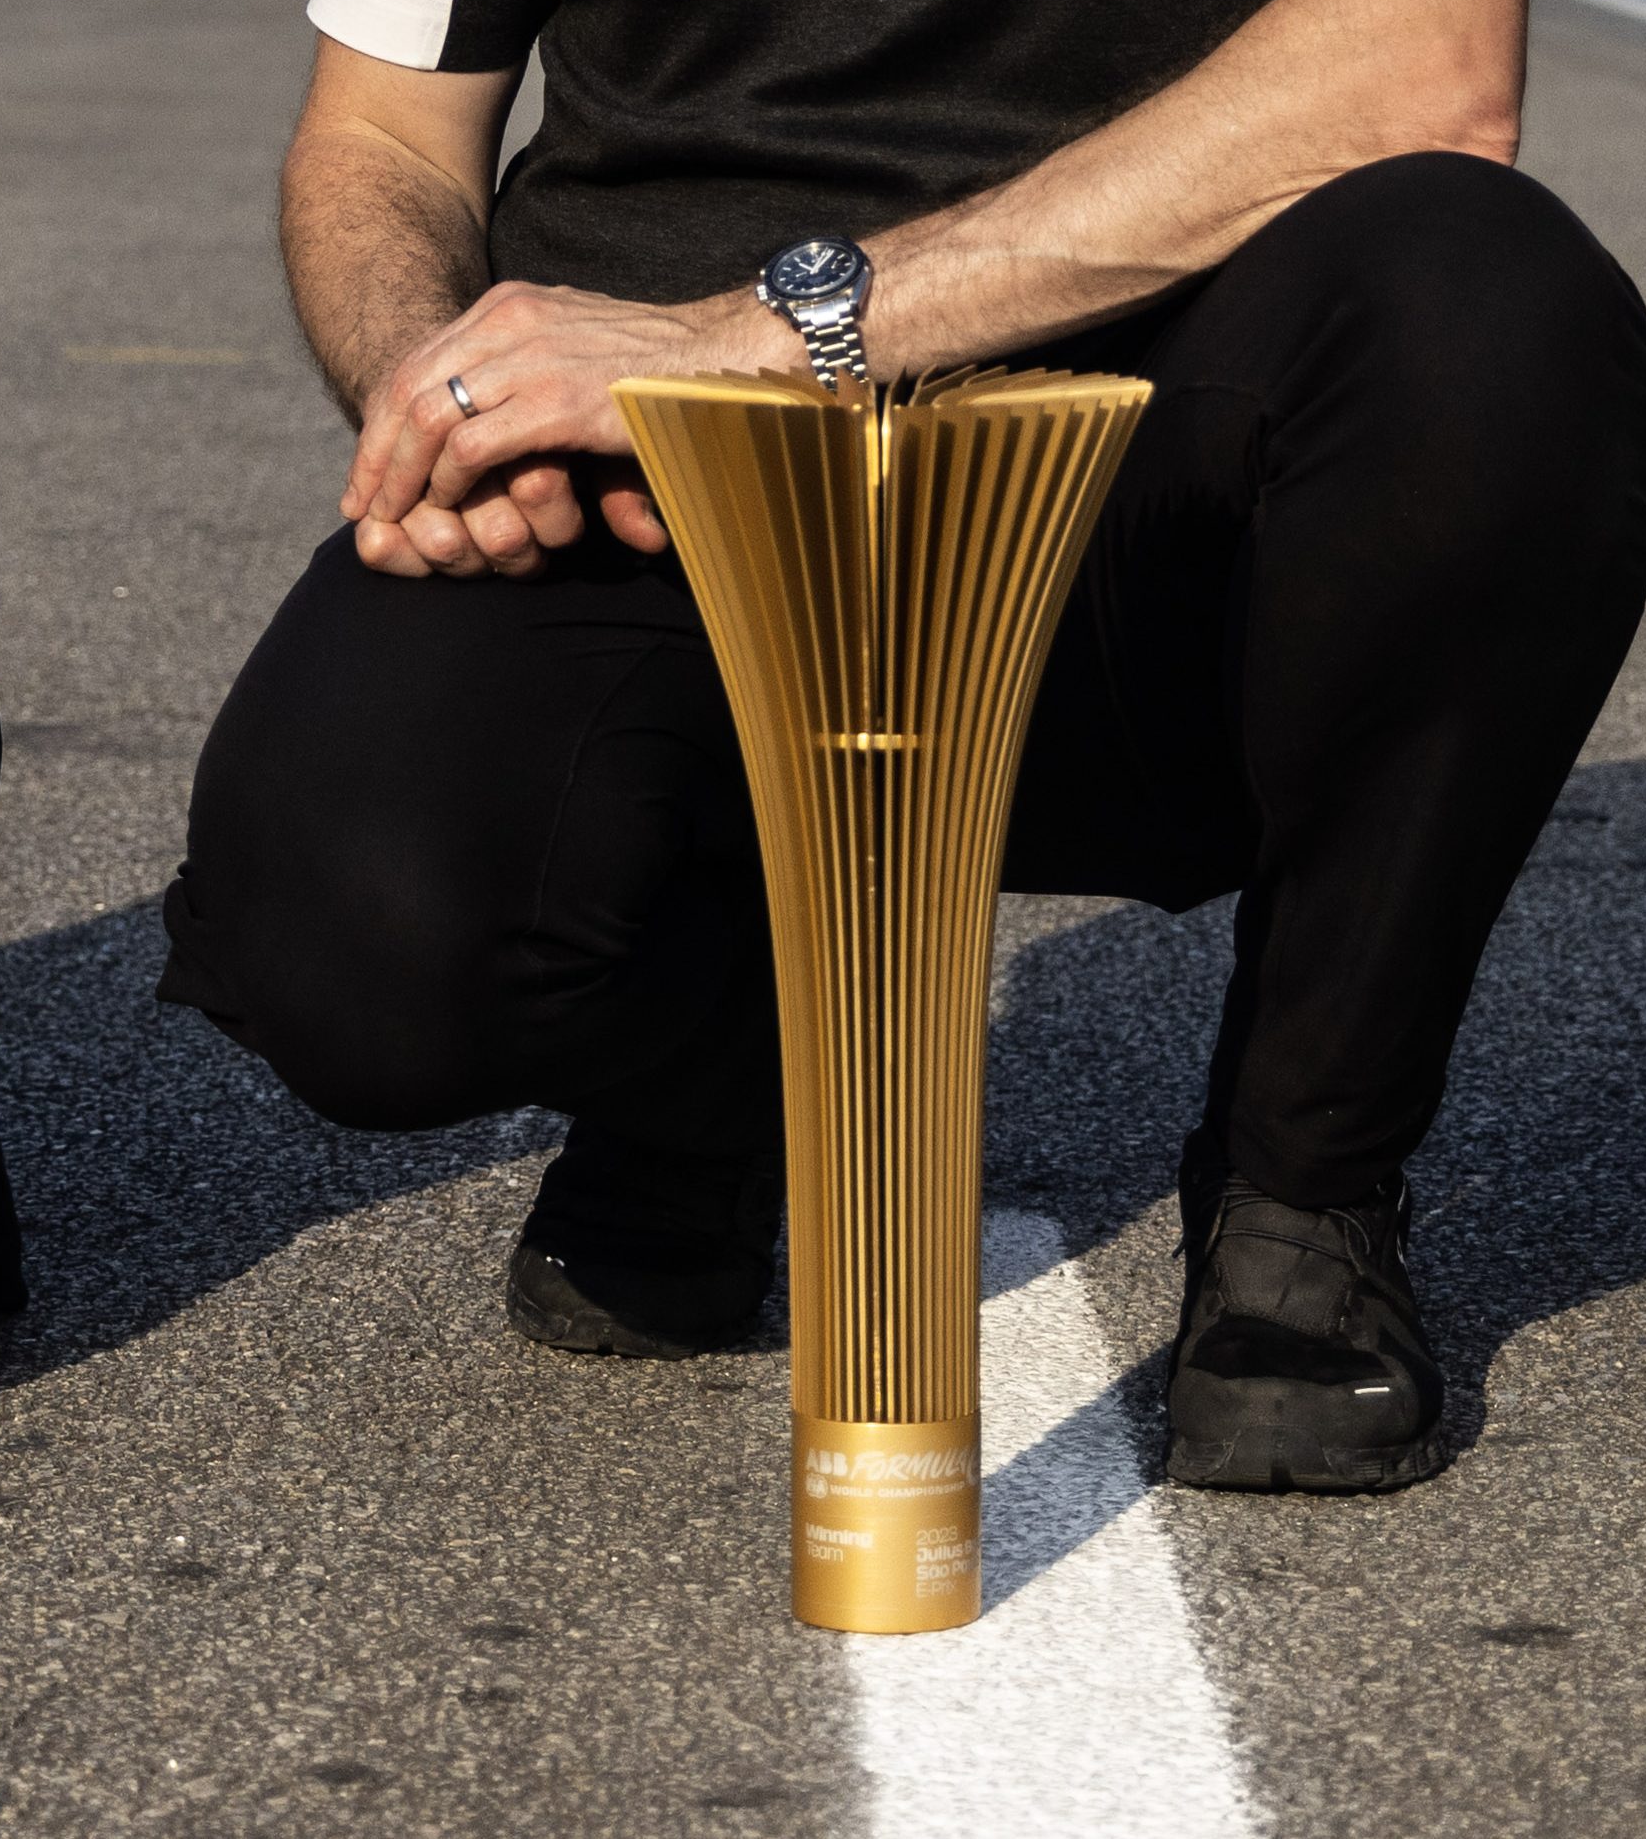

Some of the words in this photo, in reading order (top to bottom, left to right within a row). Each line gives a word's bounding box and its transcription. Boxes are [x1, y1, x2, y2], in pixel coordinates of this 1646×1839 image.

[807, 1448, 848, 1477] ABB
[806, 1522, 873, 1548] Winning
[916, 1525, 959, 1546] 2023
[807, 1539, 843, 1561] Team
